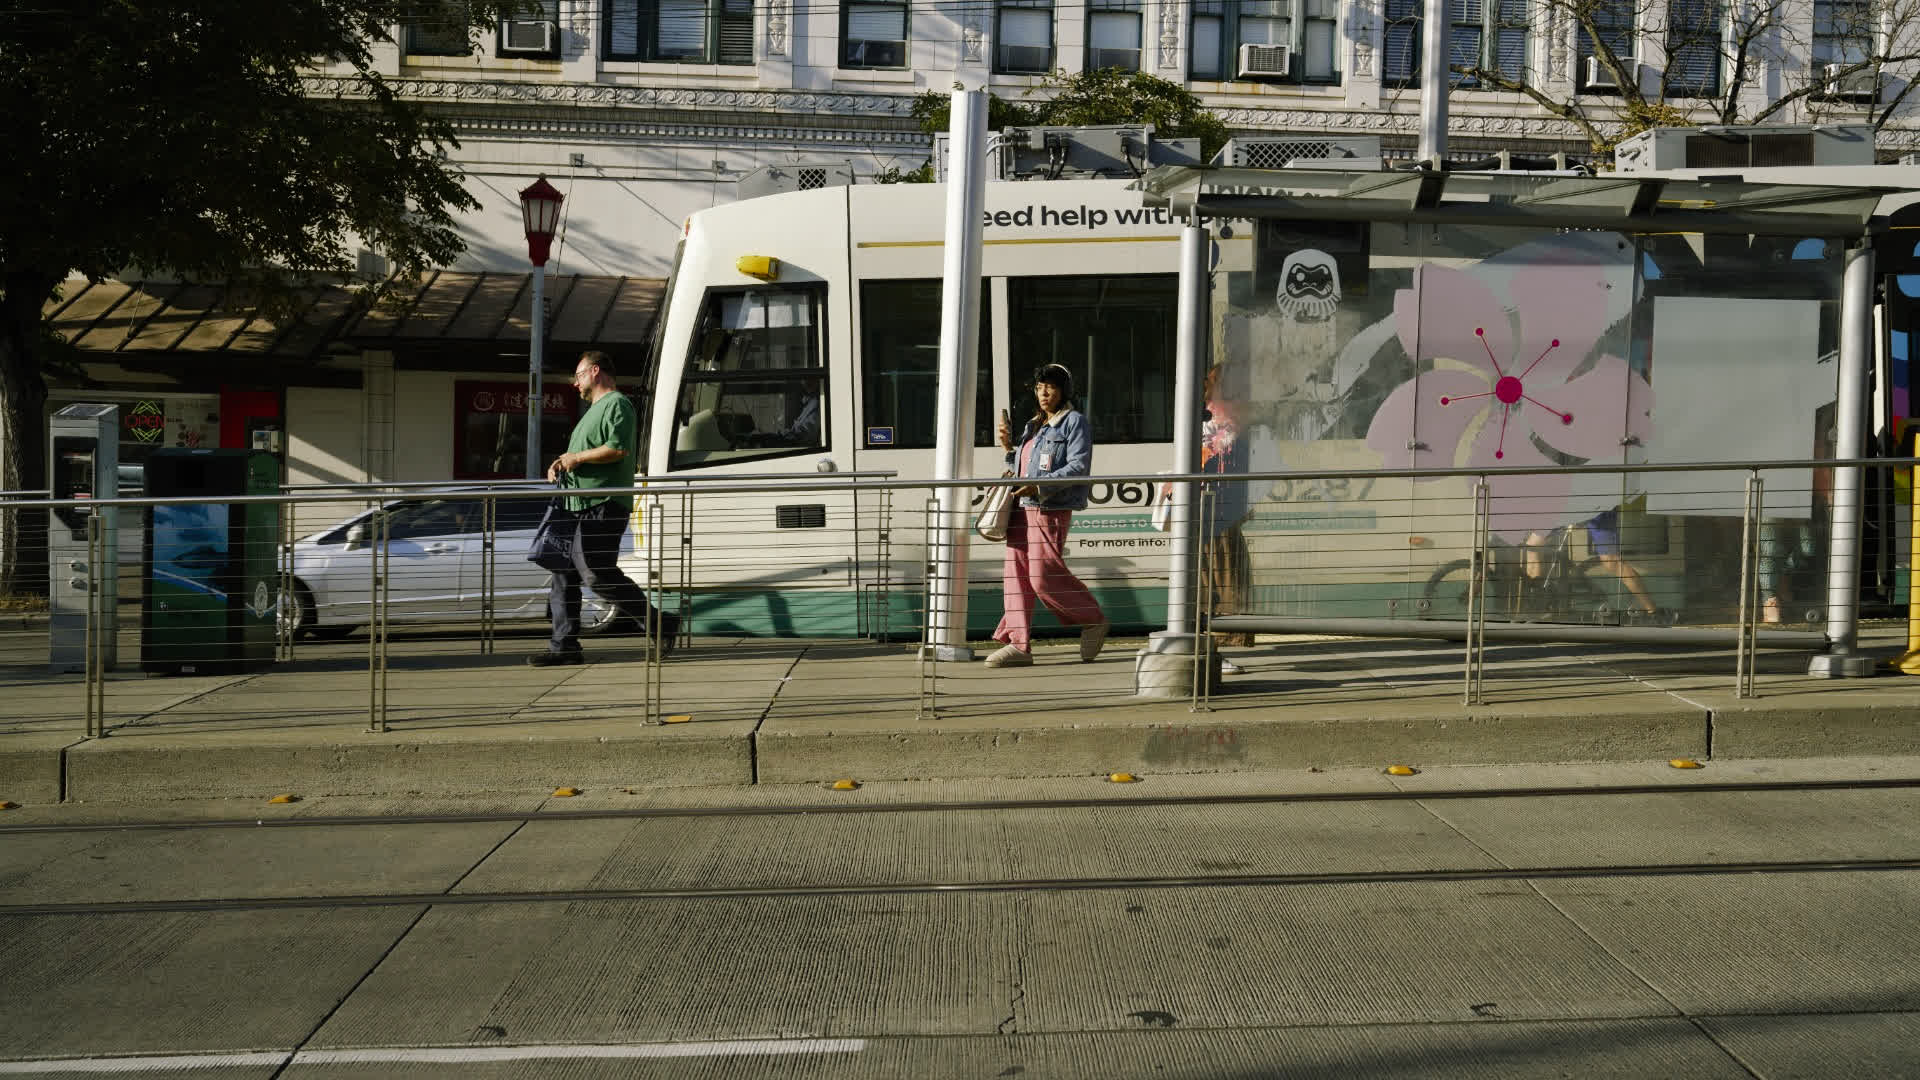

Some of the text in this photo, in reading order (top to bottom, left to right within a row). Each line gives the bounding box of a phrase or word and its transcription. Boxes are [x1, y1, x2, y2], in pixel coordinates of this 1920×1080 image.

[983, 206, 1034, 227] eed
[1041, 205, 1108, 230] help
[125, 415, 165, 427] OPEN
[1071, 518, 1148, 530] ACCESS TO
[1079, 538, 1166, 548] For more info:
